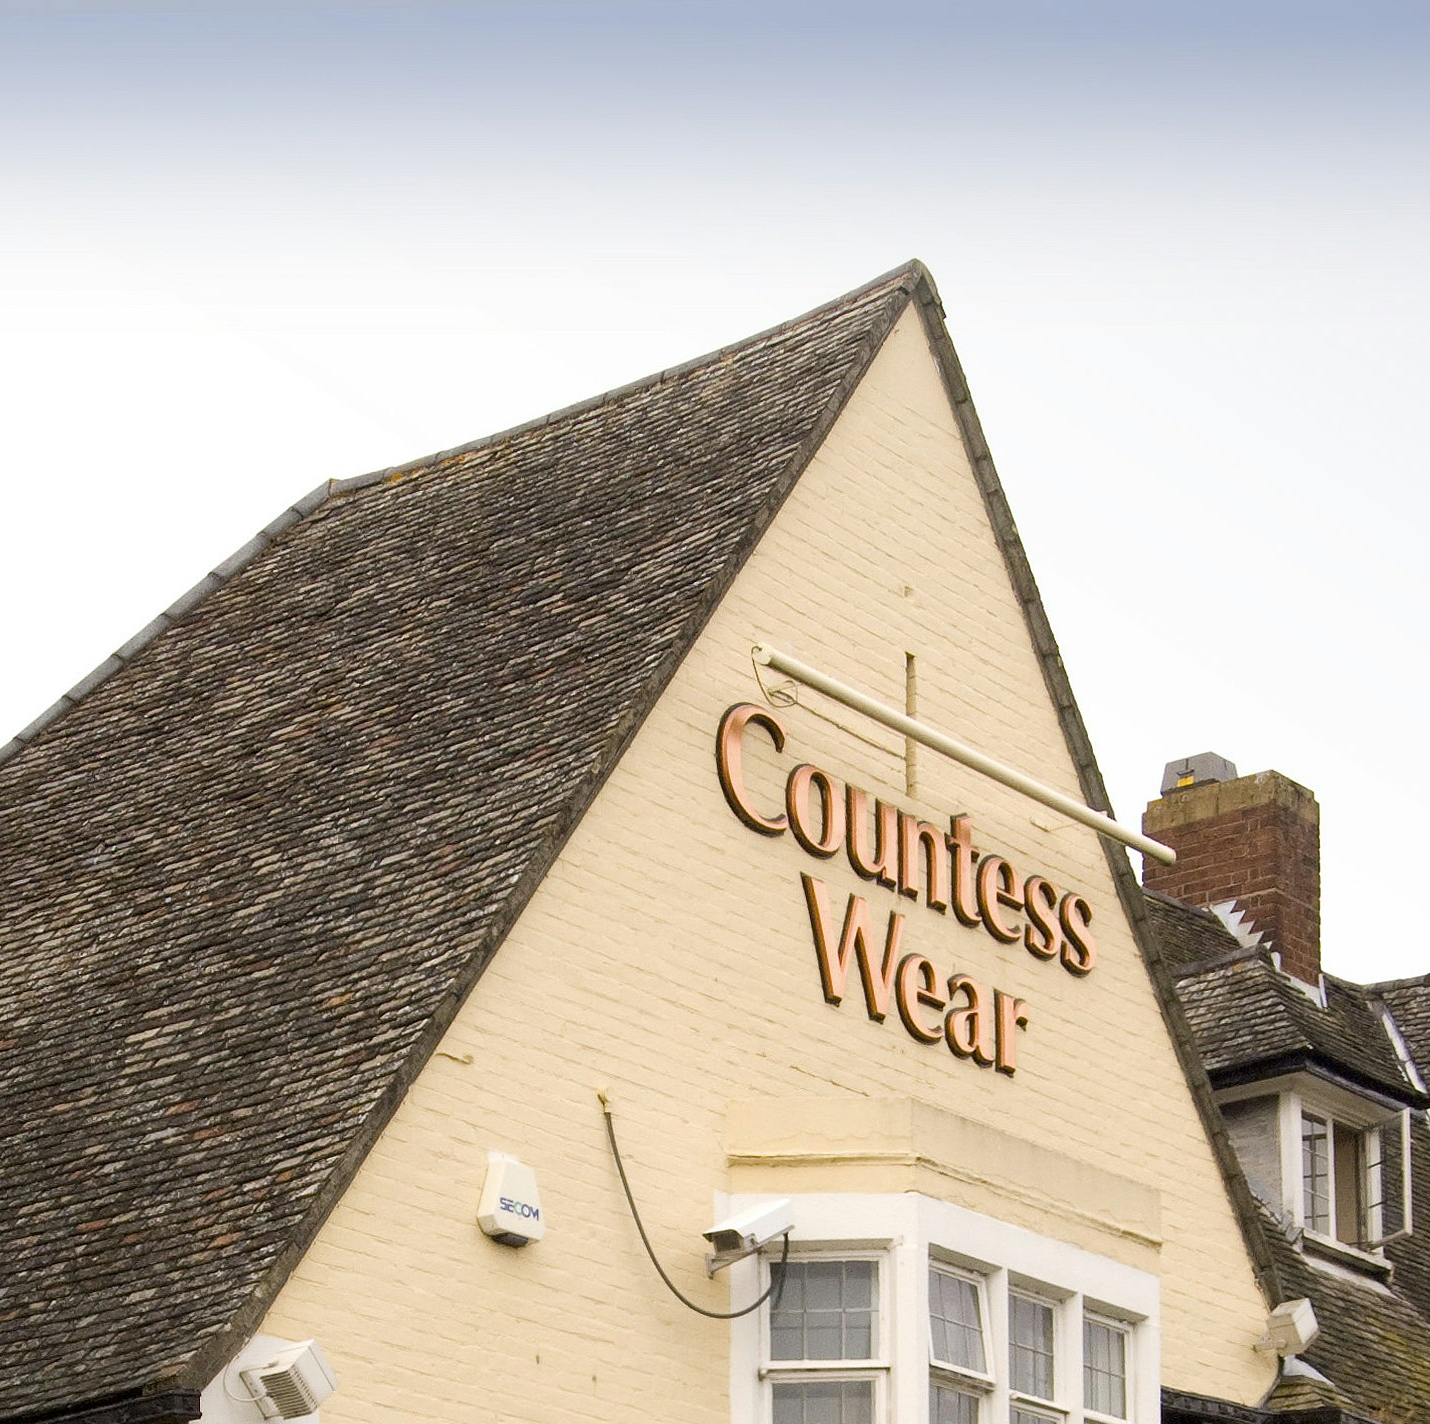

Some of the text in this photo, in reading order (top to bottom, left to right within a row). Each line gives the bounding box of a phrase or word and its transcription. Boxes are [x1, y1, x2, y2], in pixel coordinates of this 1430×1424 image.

[715, 702, 1097, 977] Countess
[800, 871, 1029, 1077] Wear
[499, 1197, 540, 1221] SECOM
